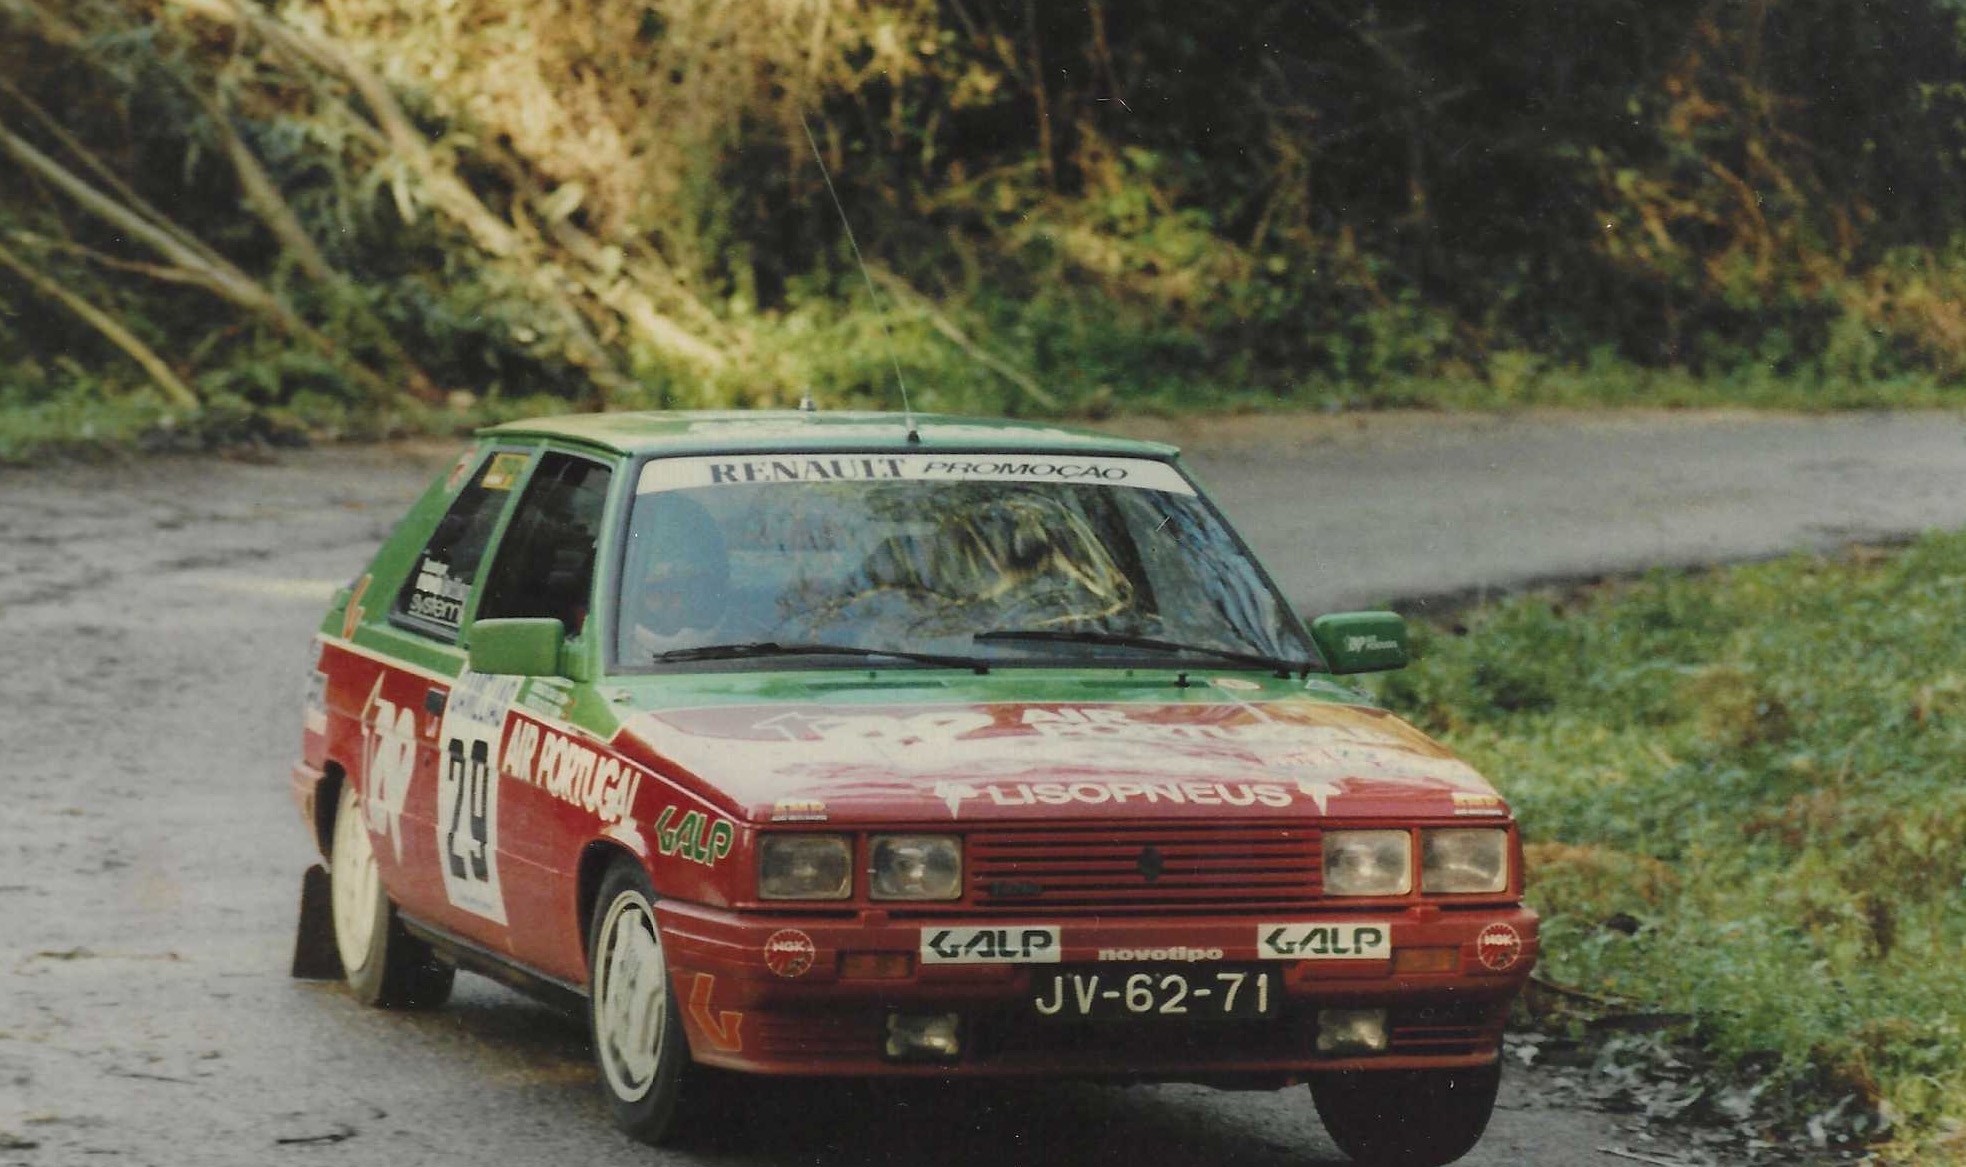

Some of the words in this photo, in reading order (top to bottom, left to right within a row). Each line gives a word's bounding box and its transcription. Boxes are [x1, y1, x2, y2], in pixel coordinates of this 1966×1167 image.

[710, 459, 906, 485] RENAULT
[501, 719, 540, 783] AIR
[536, 731, 643, 823] PORTUGAL
[987, 783, 1293, 807] LISOPNEUS
[448, 737, 490, 883] 29
[654, 805, 735, 867] GALP
[773, 941, 806, 952] NGK
[928, 930, 1053, 959] GALP
[1098, 946, 1223, 962] novotipo
[1264, 928, 1383, 956] GALP
[1035, 972, 1269, 1015] JV-62-71
